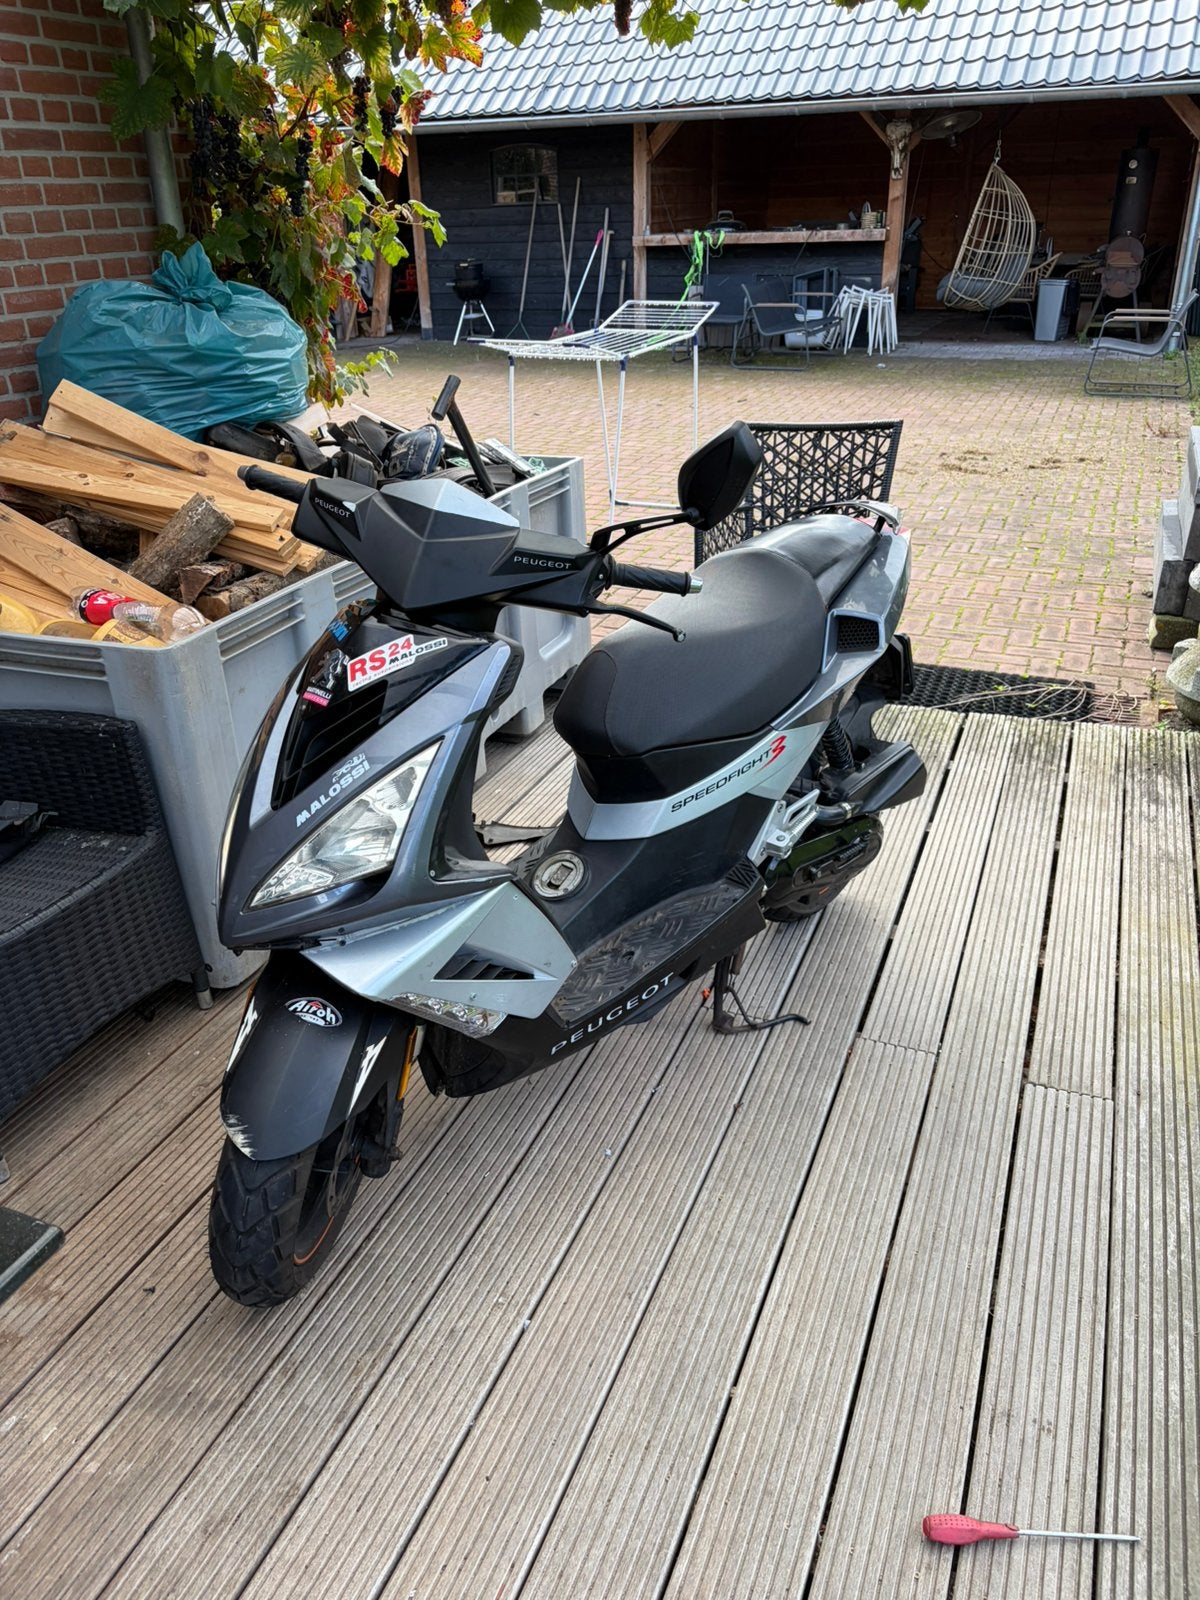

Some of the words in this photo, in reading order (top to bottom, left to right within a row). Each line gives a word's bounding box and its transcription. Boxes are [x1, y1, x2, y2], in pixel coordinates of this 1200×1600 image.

[314, 497, 351, 518] PEUGEOT
[514, 556, 572, 570] PEUGEOT
[350, 637, 413, 682] RS24
[388, 638, 447, 666] MALOSSI
[296, 760, 371, 828] MALOSSI
[671, 747, 772, 813] SPEEDFIGHT
[288, 1000, 336, 1026] Airoh
[551, 972, 675, 1056] PEUGEOT
